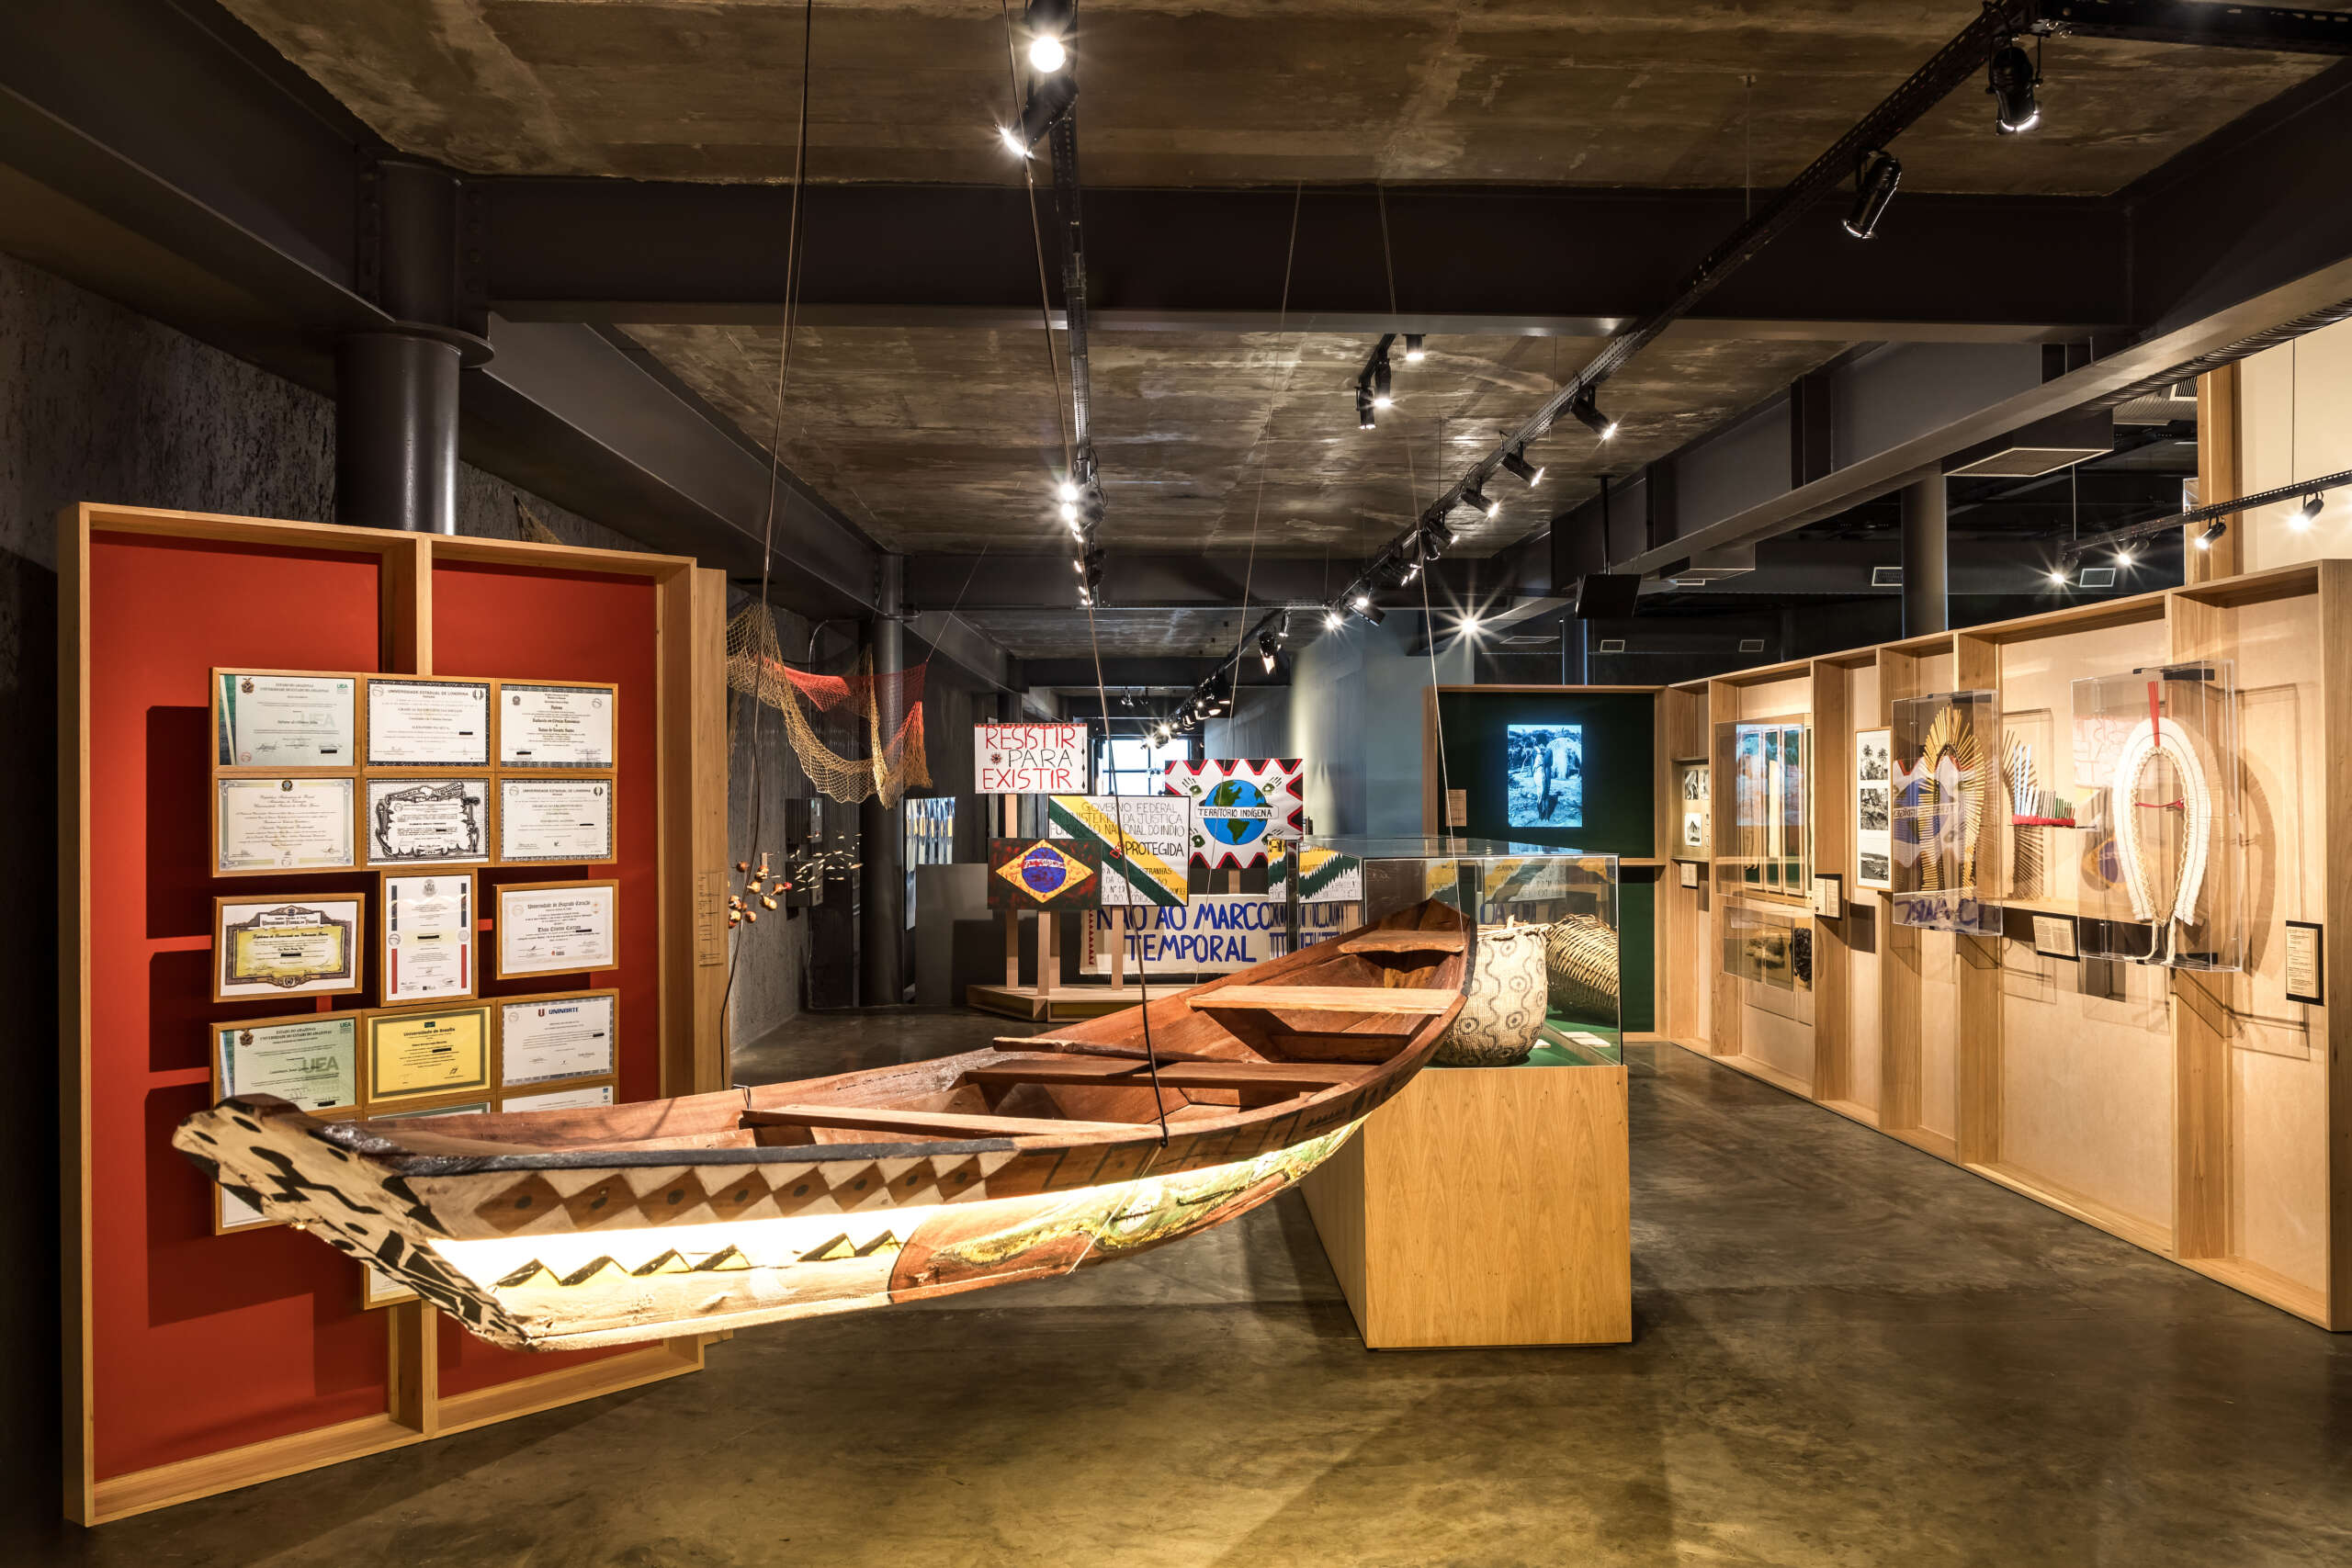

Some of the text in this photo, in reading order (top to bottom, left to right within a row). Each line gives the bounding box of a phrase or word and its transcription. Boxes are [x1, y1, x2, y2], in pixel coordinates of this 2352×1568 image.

[985, 726, 1076, 750] RESISTIR
[1008, 749, 1073, 768] PARA
[982, 768, 1072, 790] EXISTIR
[1136, 802, 1178, 813] FEDERAL
[1198, 807, 1272, 817] TERRITÓRIO INDÍGENA
[1123, 813, 1136, 824] DA
[1125, 840, 1185, 857] PROTEGIDA
[1154, 906, 1187, 931] AO
[1193, 902, 1272, 931] MARCO
[1124, 933, 1258, 964] TEMPORAL
